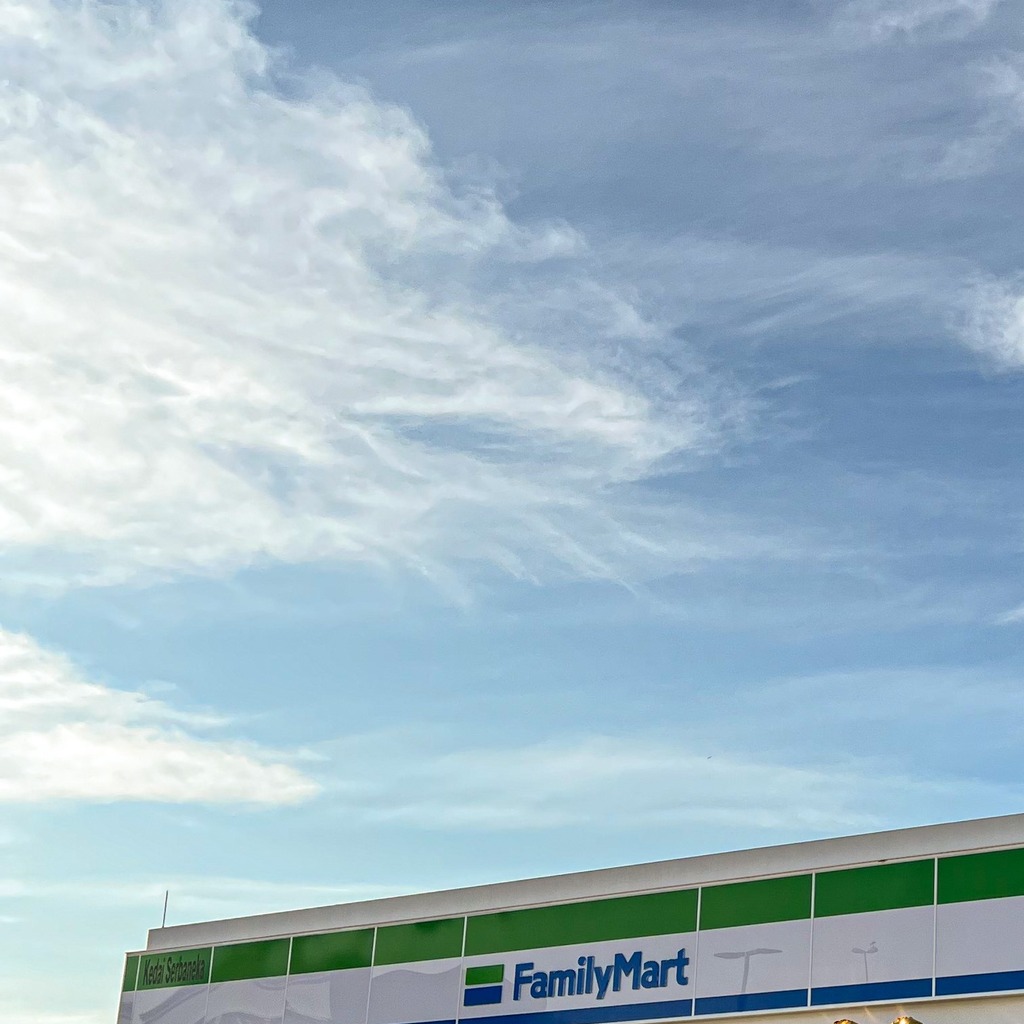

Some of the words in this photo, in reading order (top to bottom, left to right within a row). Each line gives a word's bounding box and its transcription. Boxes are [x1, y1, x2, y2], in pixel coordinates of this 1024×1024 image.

[143, 959, 165, 985] Kedai
[165, 954, 205, 983] Serbaneka
[512, 948, 690, 1001] FamilyMart
